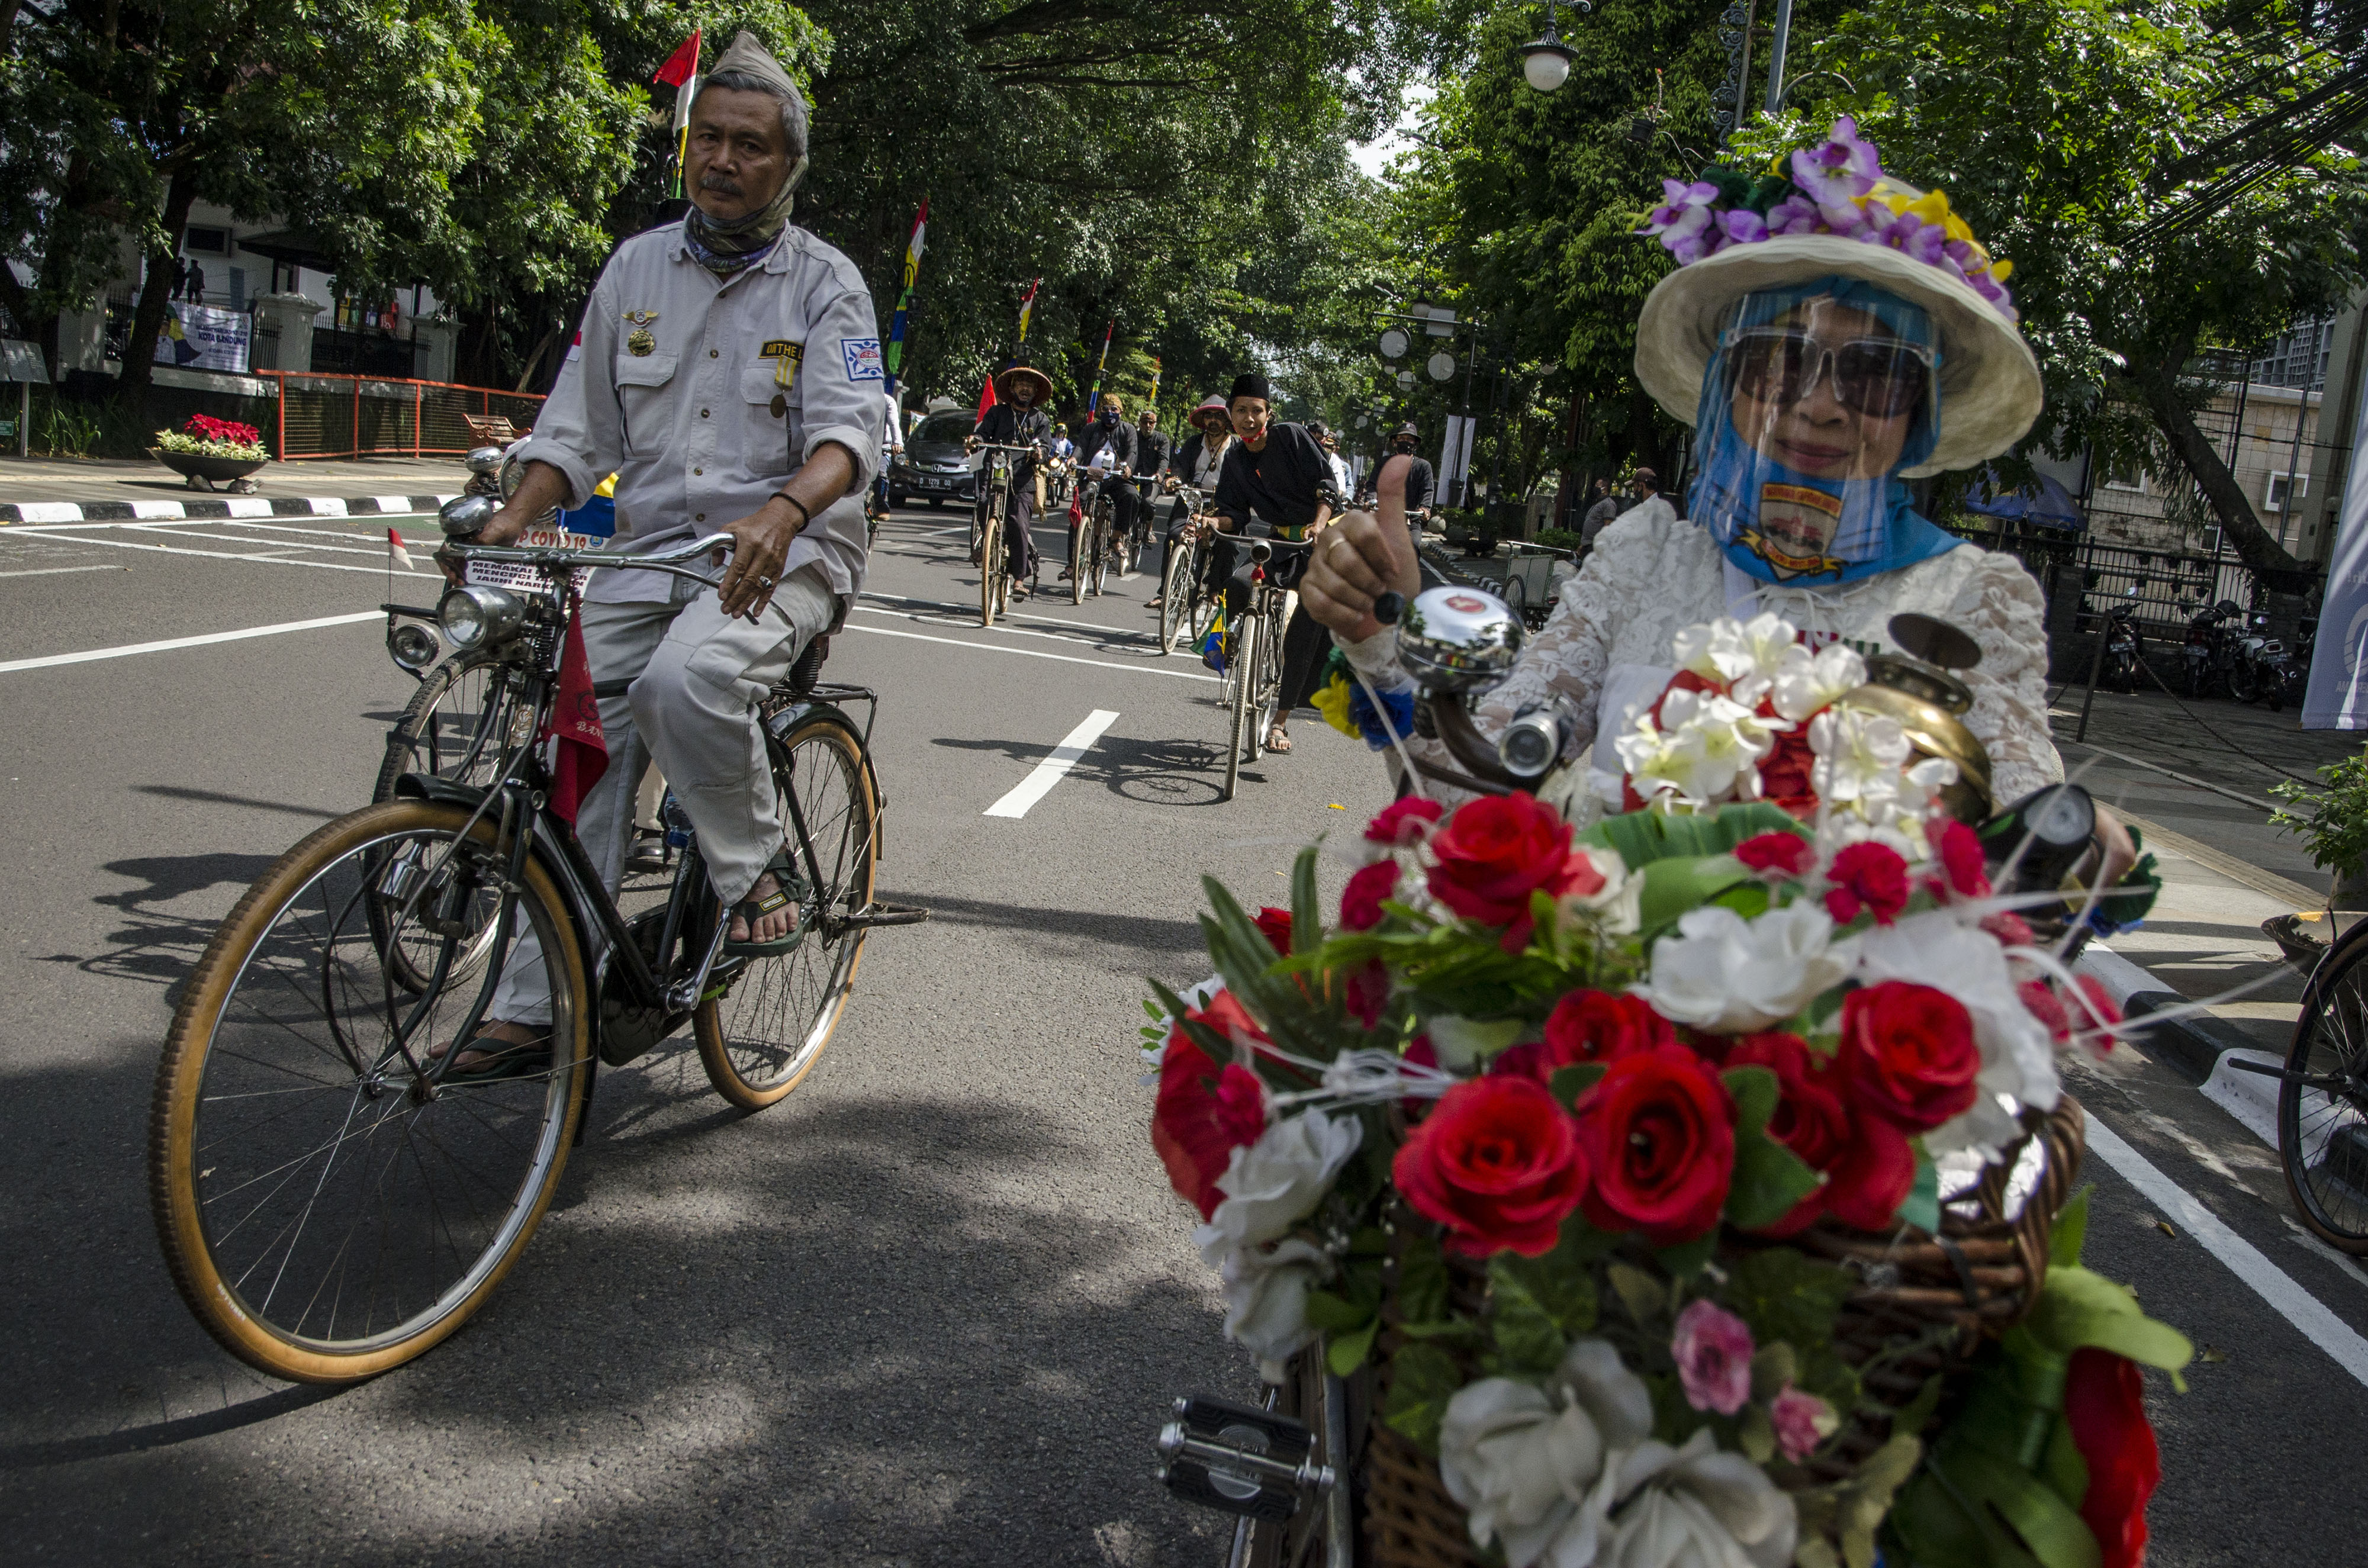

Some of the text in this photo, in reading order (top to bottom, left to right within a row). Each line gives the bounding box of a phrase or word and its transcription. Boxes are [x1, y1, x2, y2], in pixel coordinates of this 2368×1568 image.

[198, 331, 247, 346] KOTA BANDUNG
[531, 530, 571, 549] COVD
[574, 536, 587, 550] 19
[472, 562, 533, 574] MEMAKAI
[472, 568, 532, 580] MENCUCI
[475, 575, 513, 584] JAUHI
